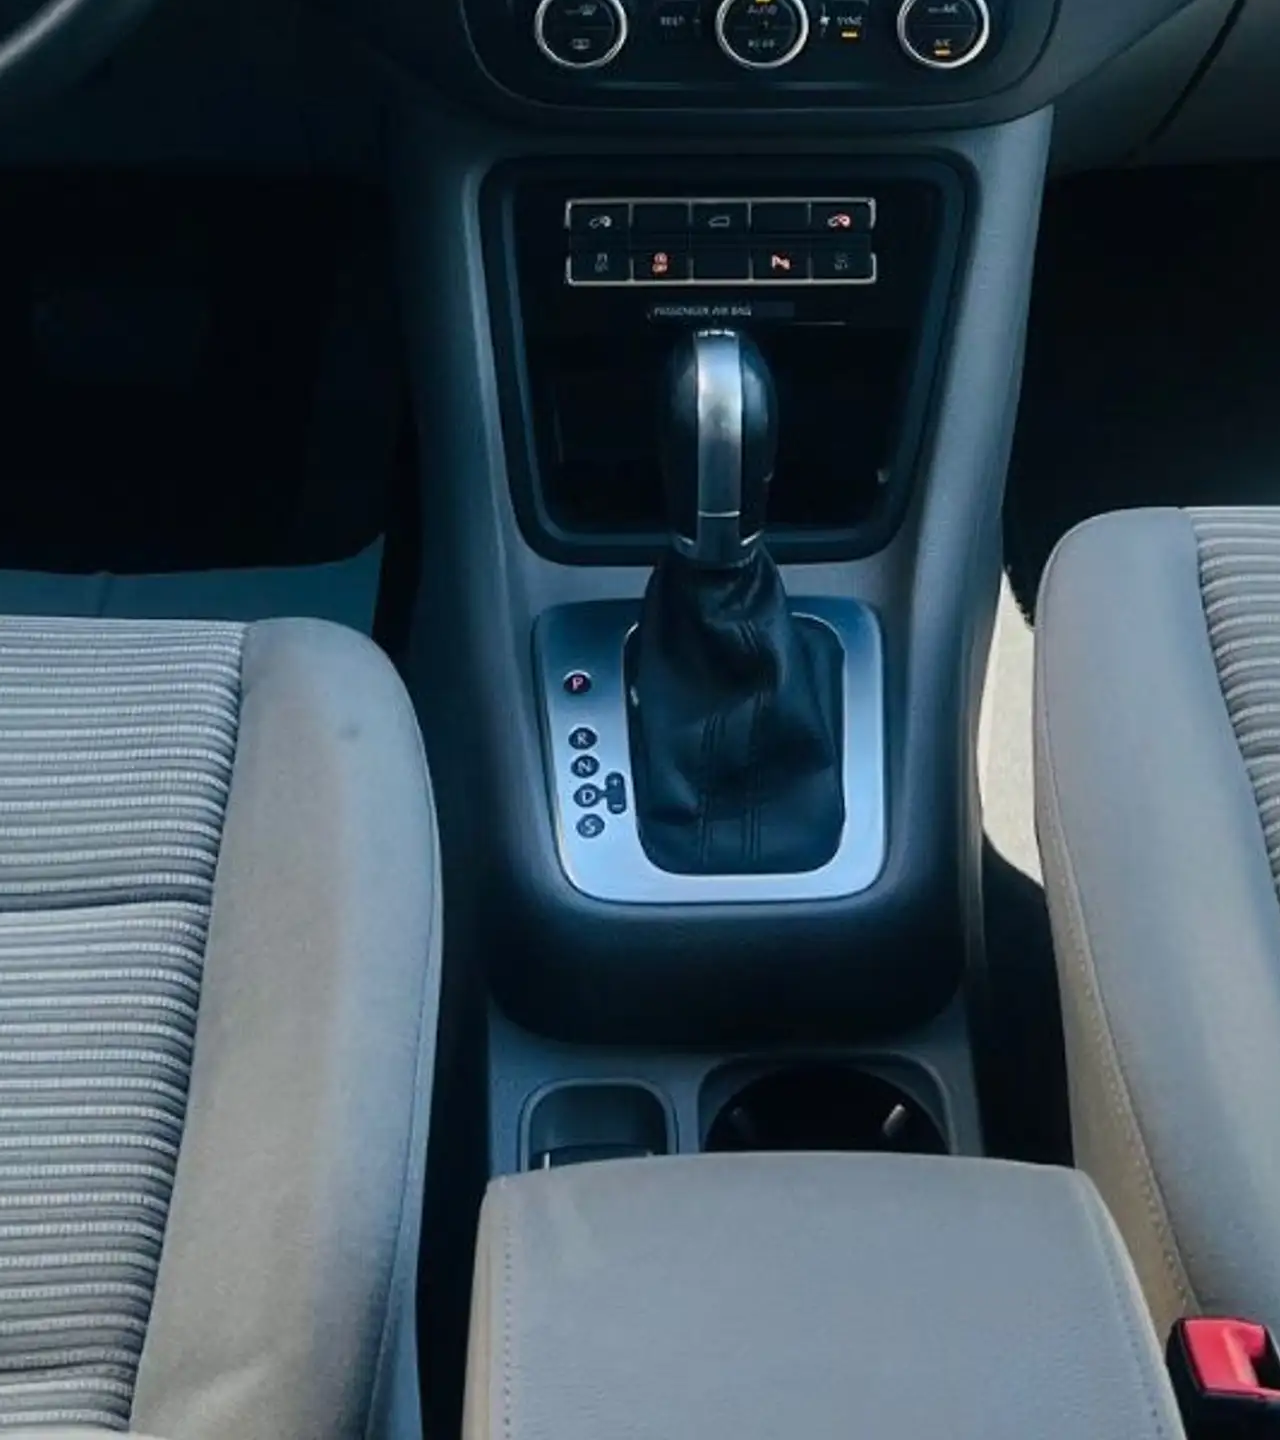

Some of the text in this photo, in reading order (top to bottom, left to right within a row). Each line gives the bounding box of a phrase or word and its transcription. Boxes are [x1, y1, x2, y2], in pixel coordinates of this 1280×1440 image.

[572, 676, 584, 691] P
[577, 732, 588, 746] R
[578, 760, 591, 773] N
[582, 788, 595, 803] D
[584, 819, 596, 835] S
